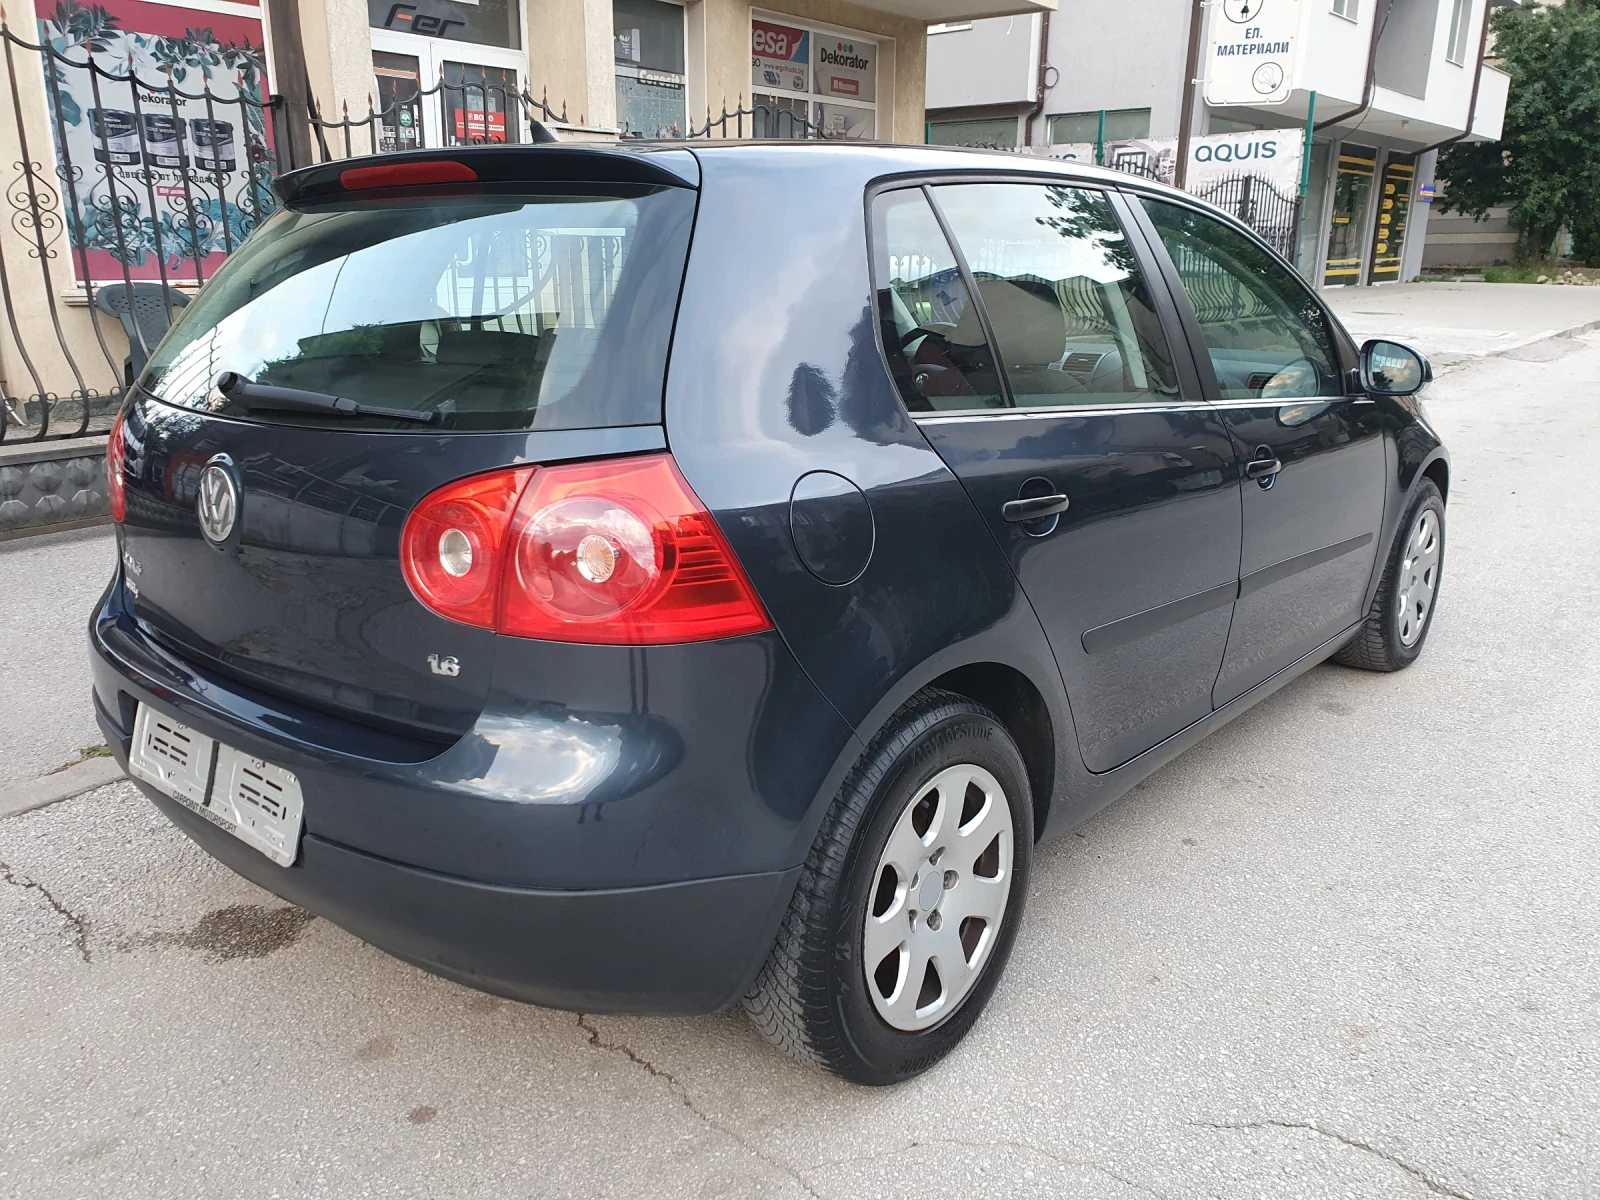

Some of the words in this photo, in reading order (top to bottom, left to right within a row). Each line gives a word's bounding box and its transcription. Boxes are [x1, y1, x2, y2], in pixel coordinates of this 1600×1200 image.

[384, 3, 465, 36] Fer
[752, 28, 788, 56] esa
[1245, 27, 1263, 39] ЕЛ.
[820, 46, 869, 71] Dekorator
[1217, 41, 1289, 57] МАТЕРИАЛИ
[173, 790, 199, 812] CARPOINT
[200, 805, 237, 834] MOTORSPORT
